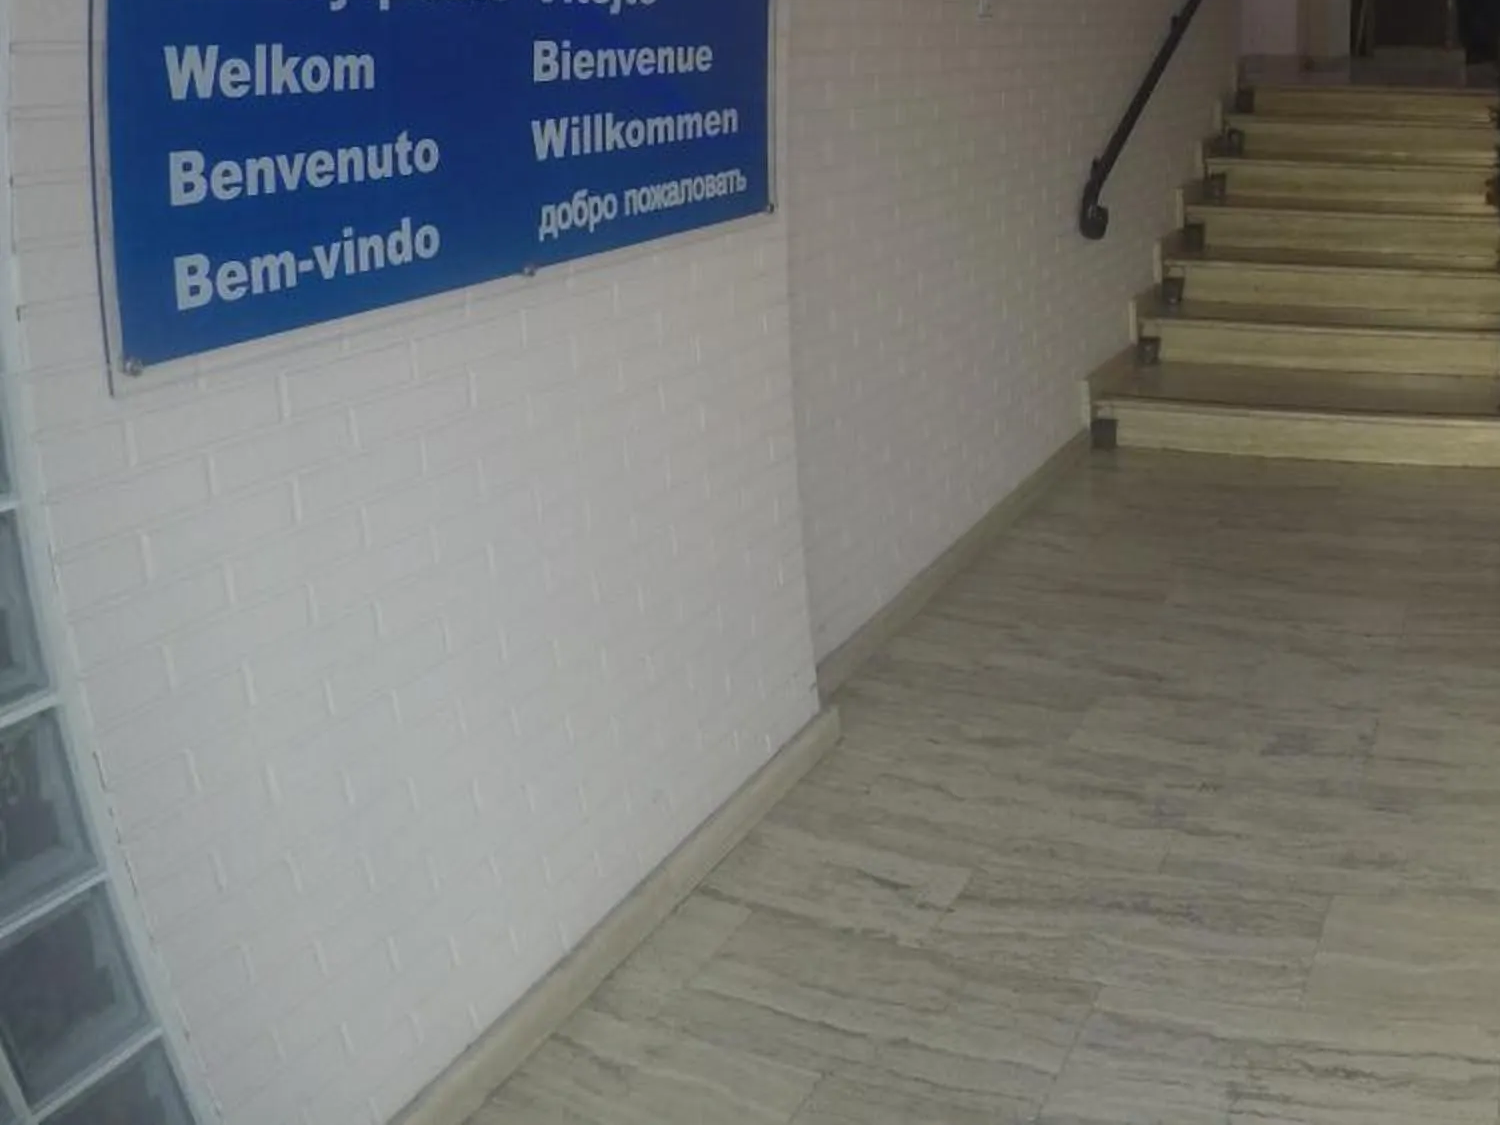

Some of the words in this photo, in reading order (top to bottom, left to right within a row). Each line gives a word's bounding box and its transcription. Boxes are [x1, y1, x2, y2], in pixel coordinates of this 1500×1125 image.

[164, 44, 375, 100] Welkom
[533, 41, 713, 82] Bienvenue
[531, 106, 738, 160] Willkommen
[169, 132, 440, 206] Benvenuto
[539, 187, 618, 241] добро
[624, 169, 747, 216] пожаловать
[174, 218, 440, 310] Bem-vindo
